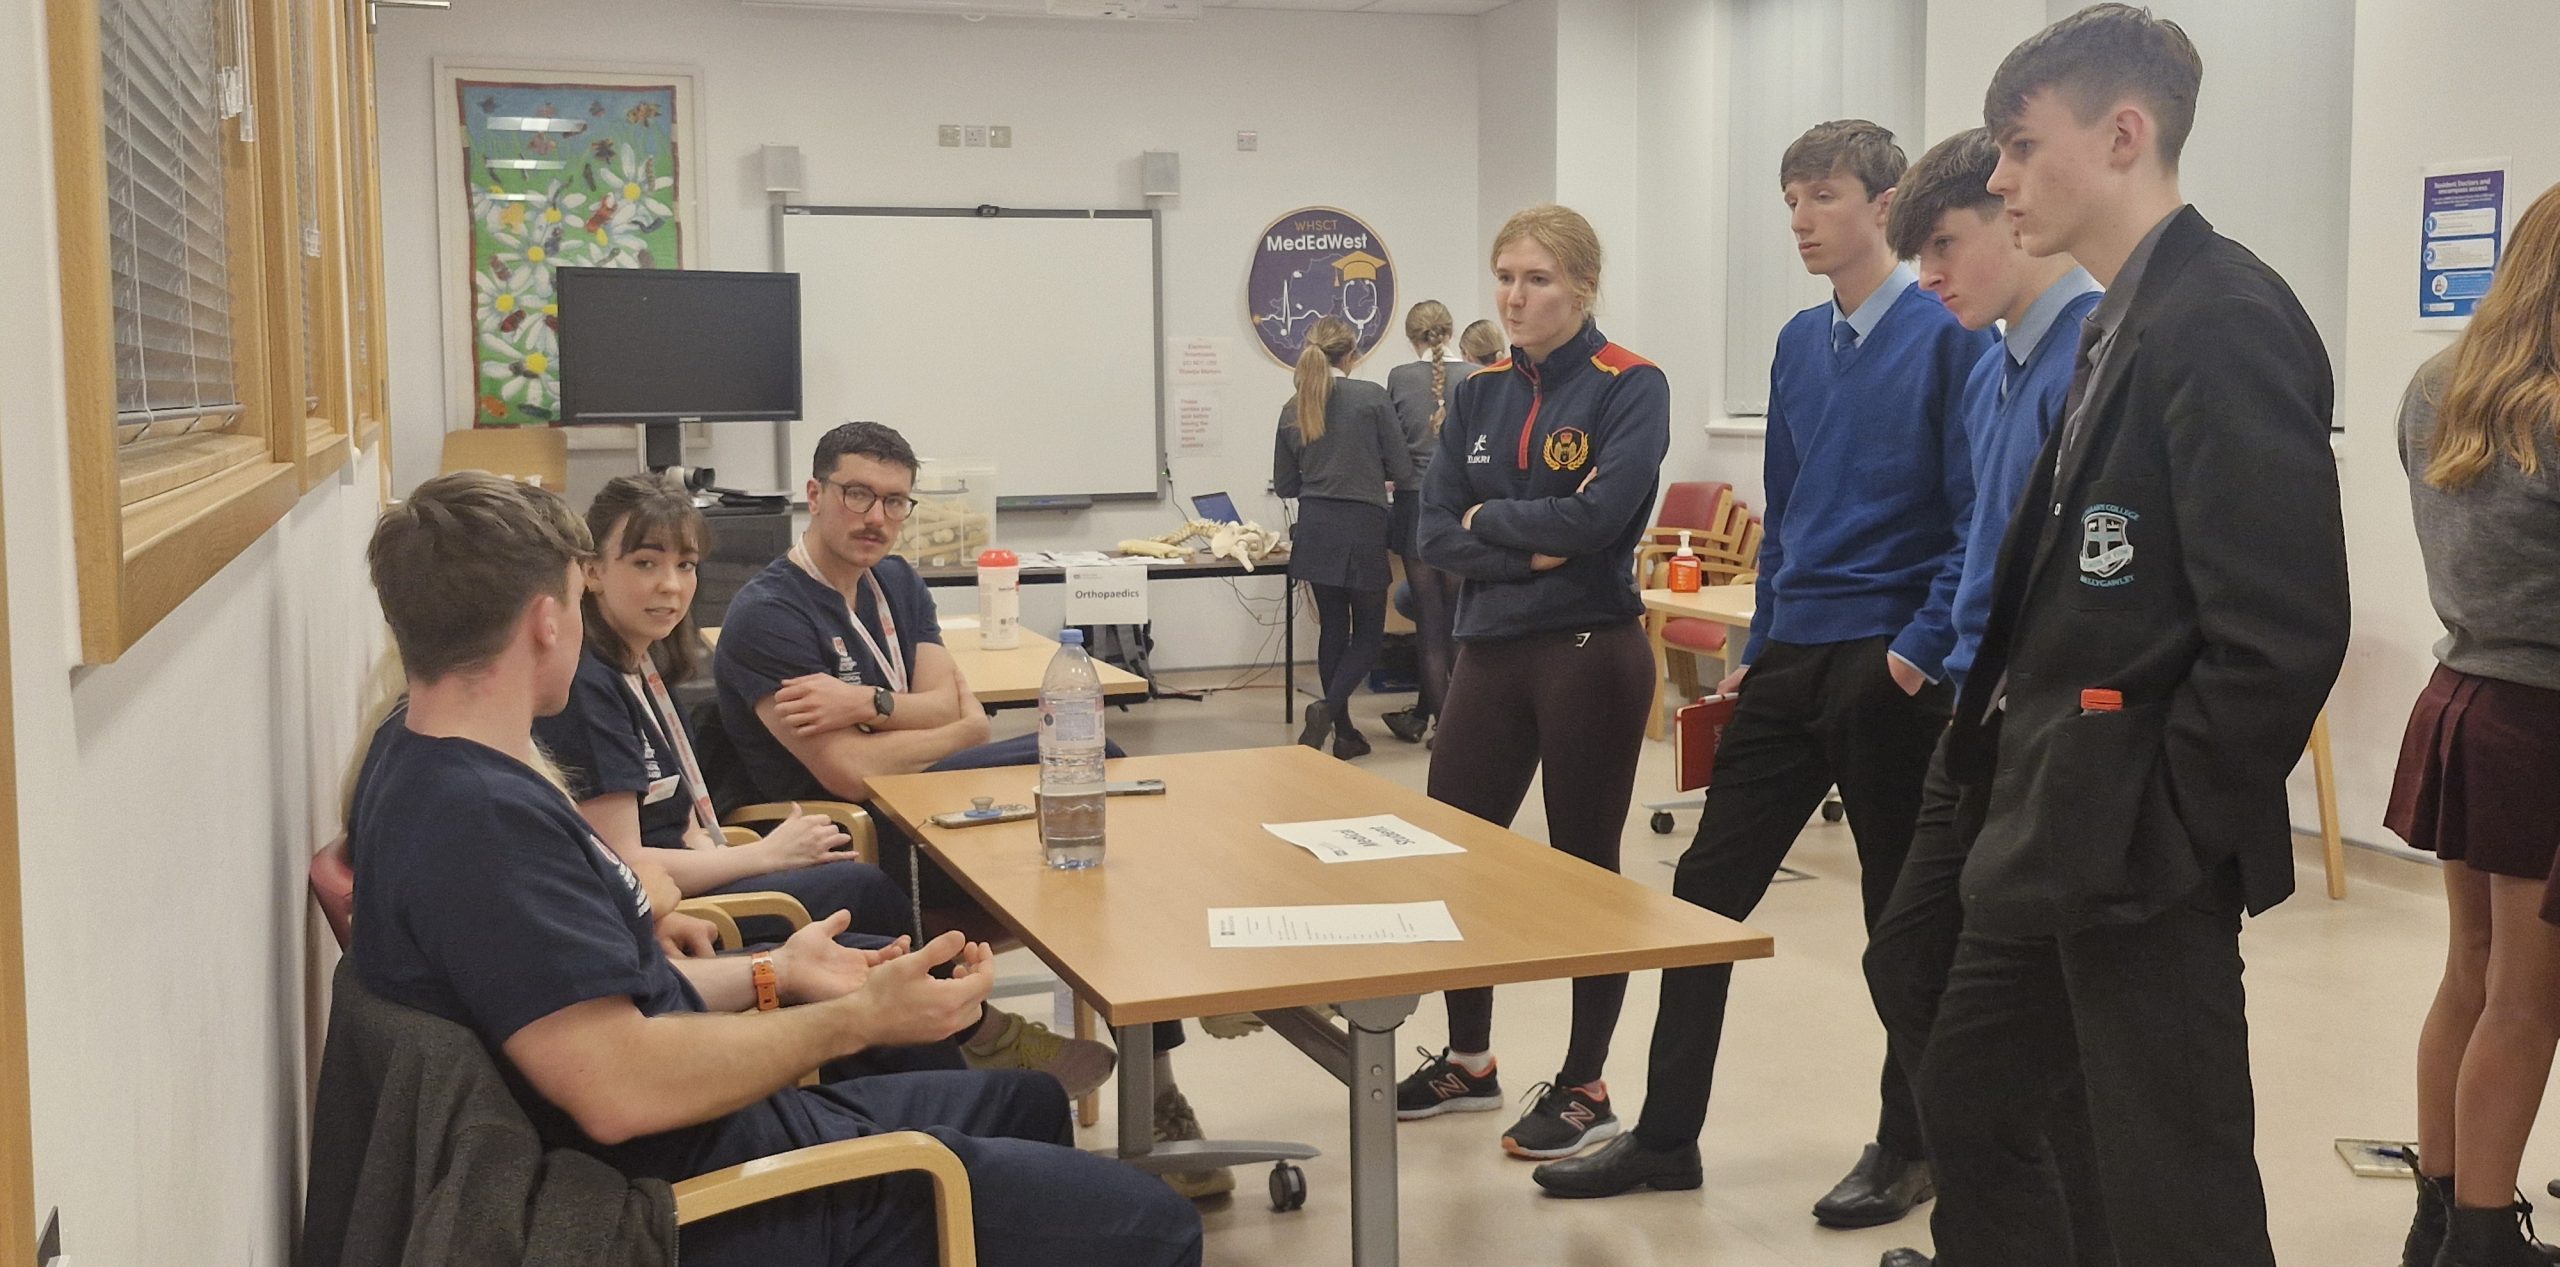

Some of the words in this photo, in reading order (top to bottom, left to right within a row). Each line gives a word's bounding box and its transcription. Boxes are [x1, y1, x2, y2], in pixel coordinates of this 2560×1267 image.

[1294, 219, 1339, 232] WHSCT
[1266, 233, 1368, 252] MedEdWest
[2105, 504, 2140, 521] COLLEGE
[1075, 588, 1139, 600] Orthopaedics
[1560, 1100, 1597, 1131] N
